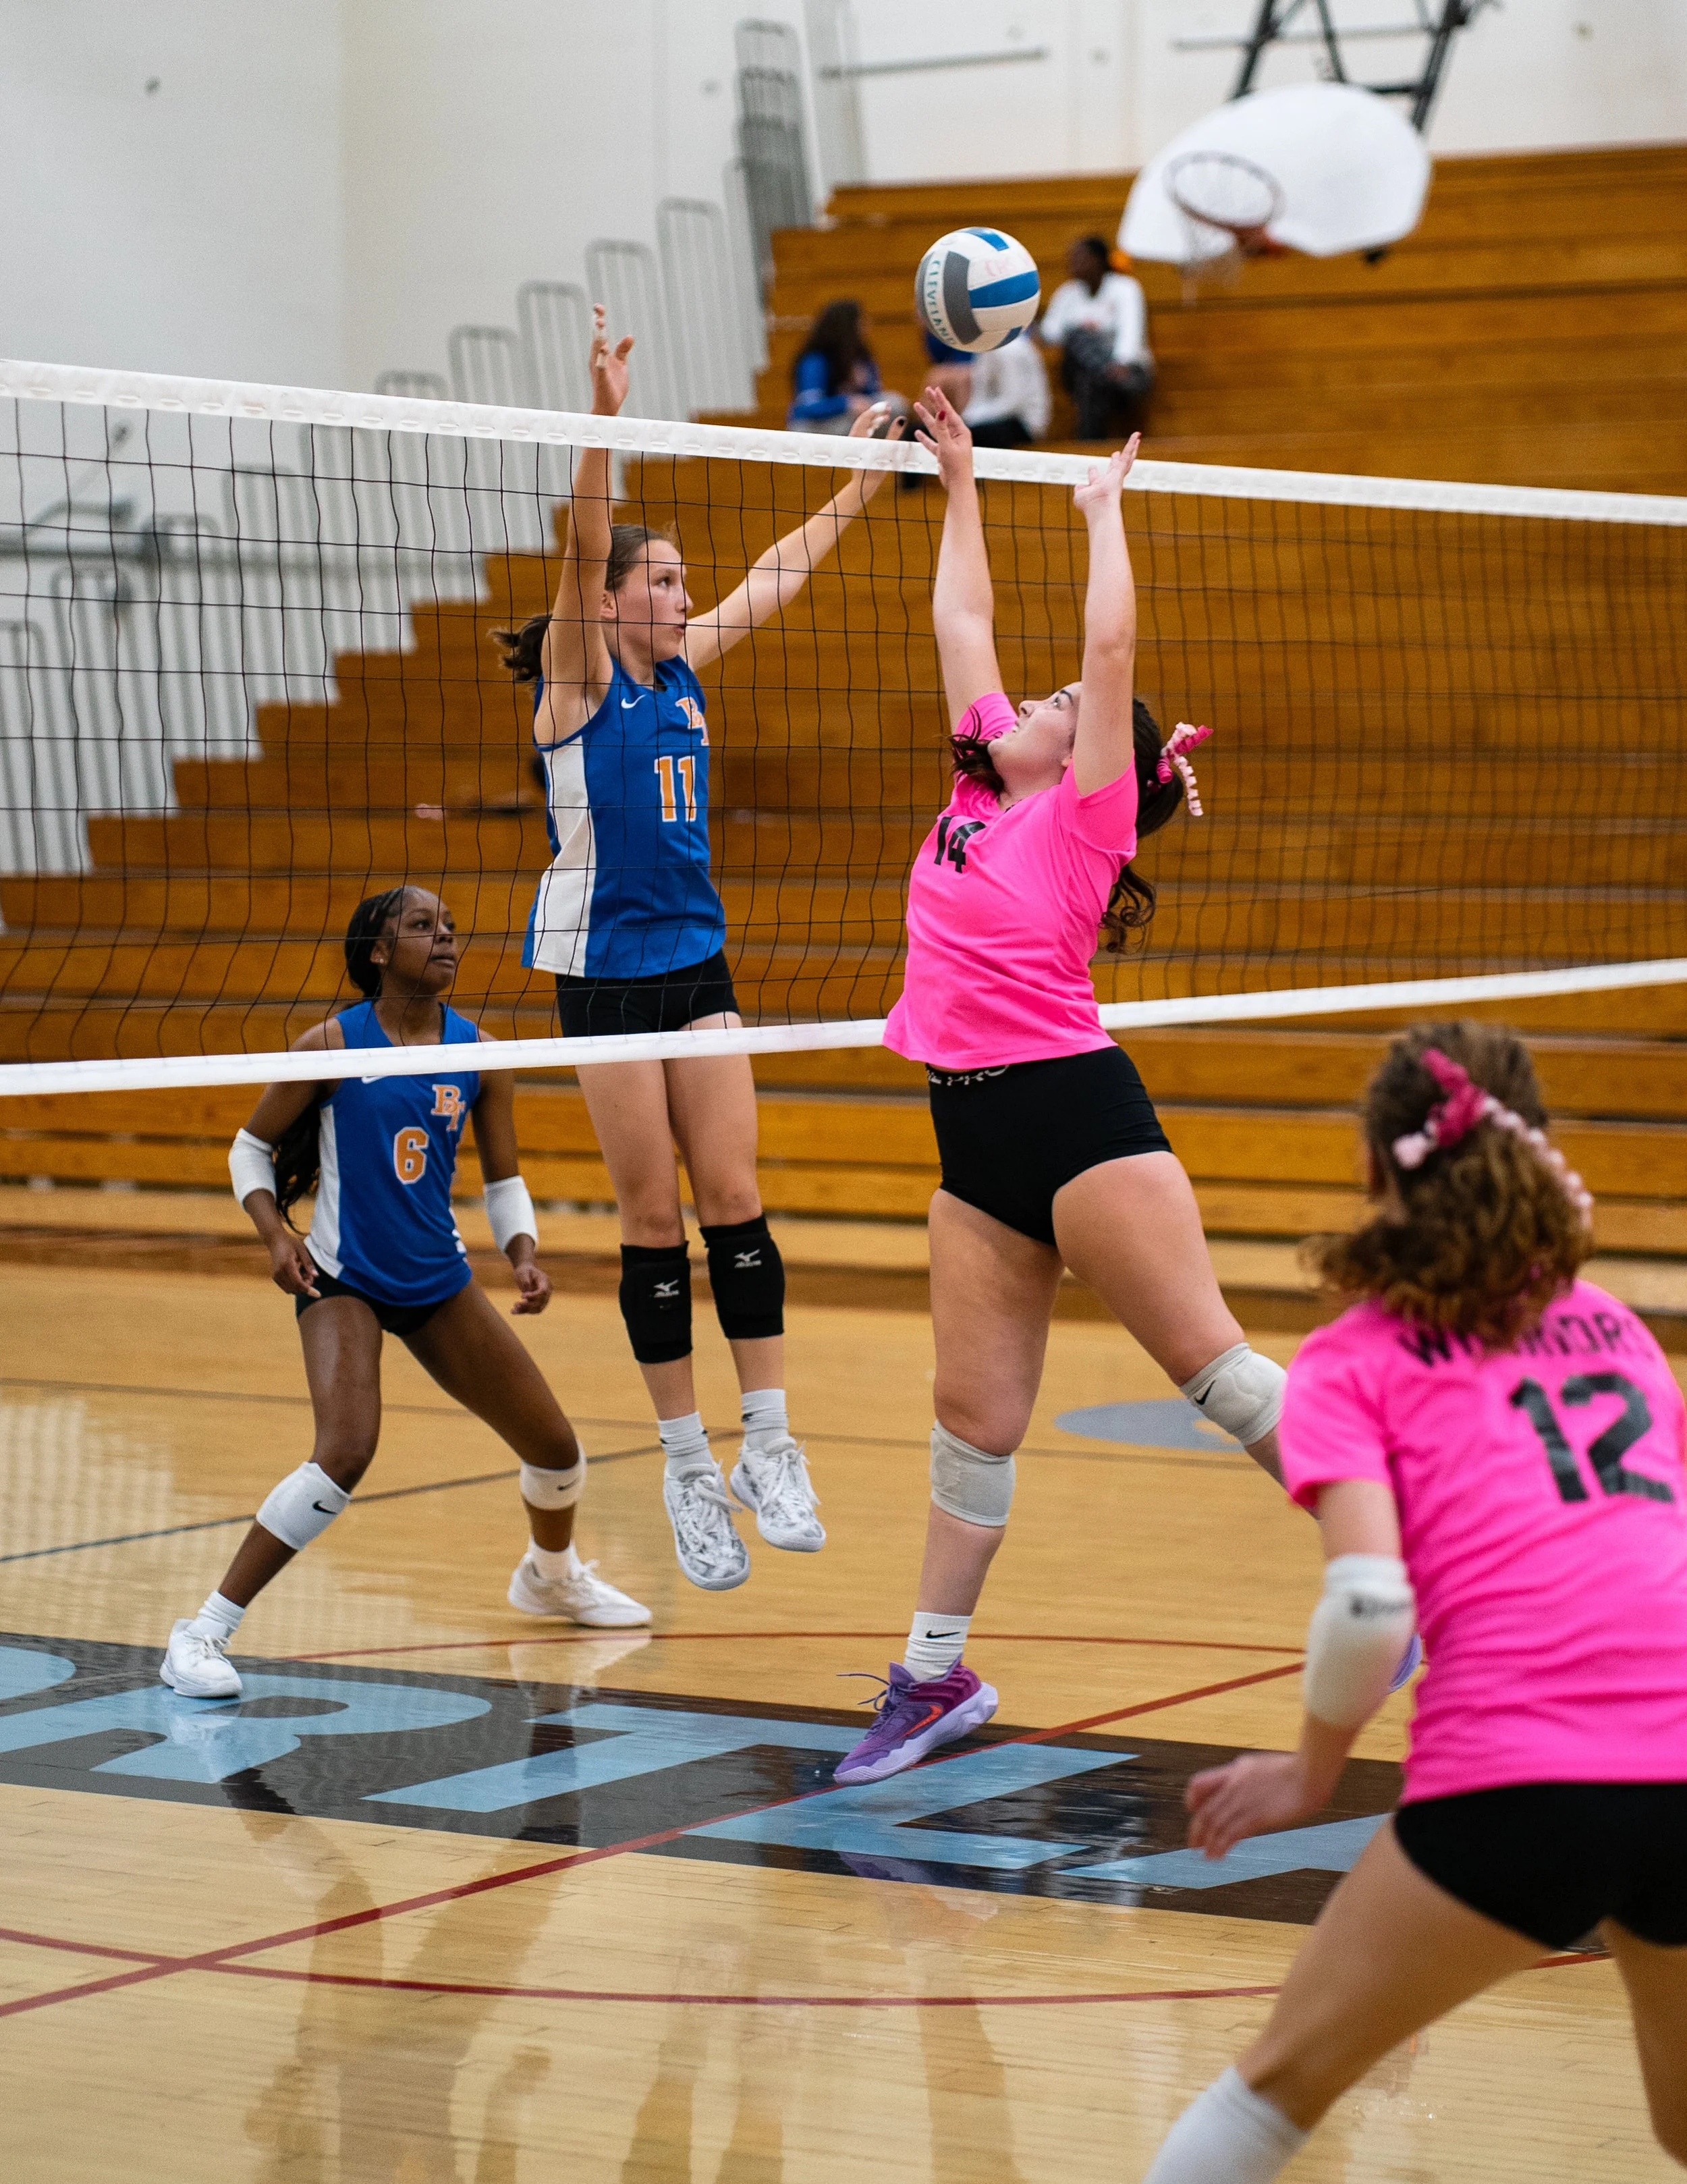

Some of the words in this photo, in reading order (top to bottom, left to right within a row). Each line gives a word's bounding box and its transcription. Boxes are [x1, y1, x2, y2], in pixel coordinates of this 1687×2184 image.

[654, 755, 697, 822] 11
[934, 815, 987, 874] 14
[393, 1126, 429, 1185] 6
[1509, 1371, 1677, 1504] 12
